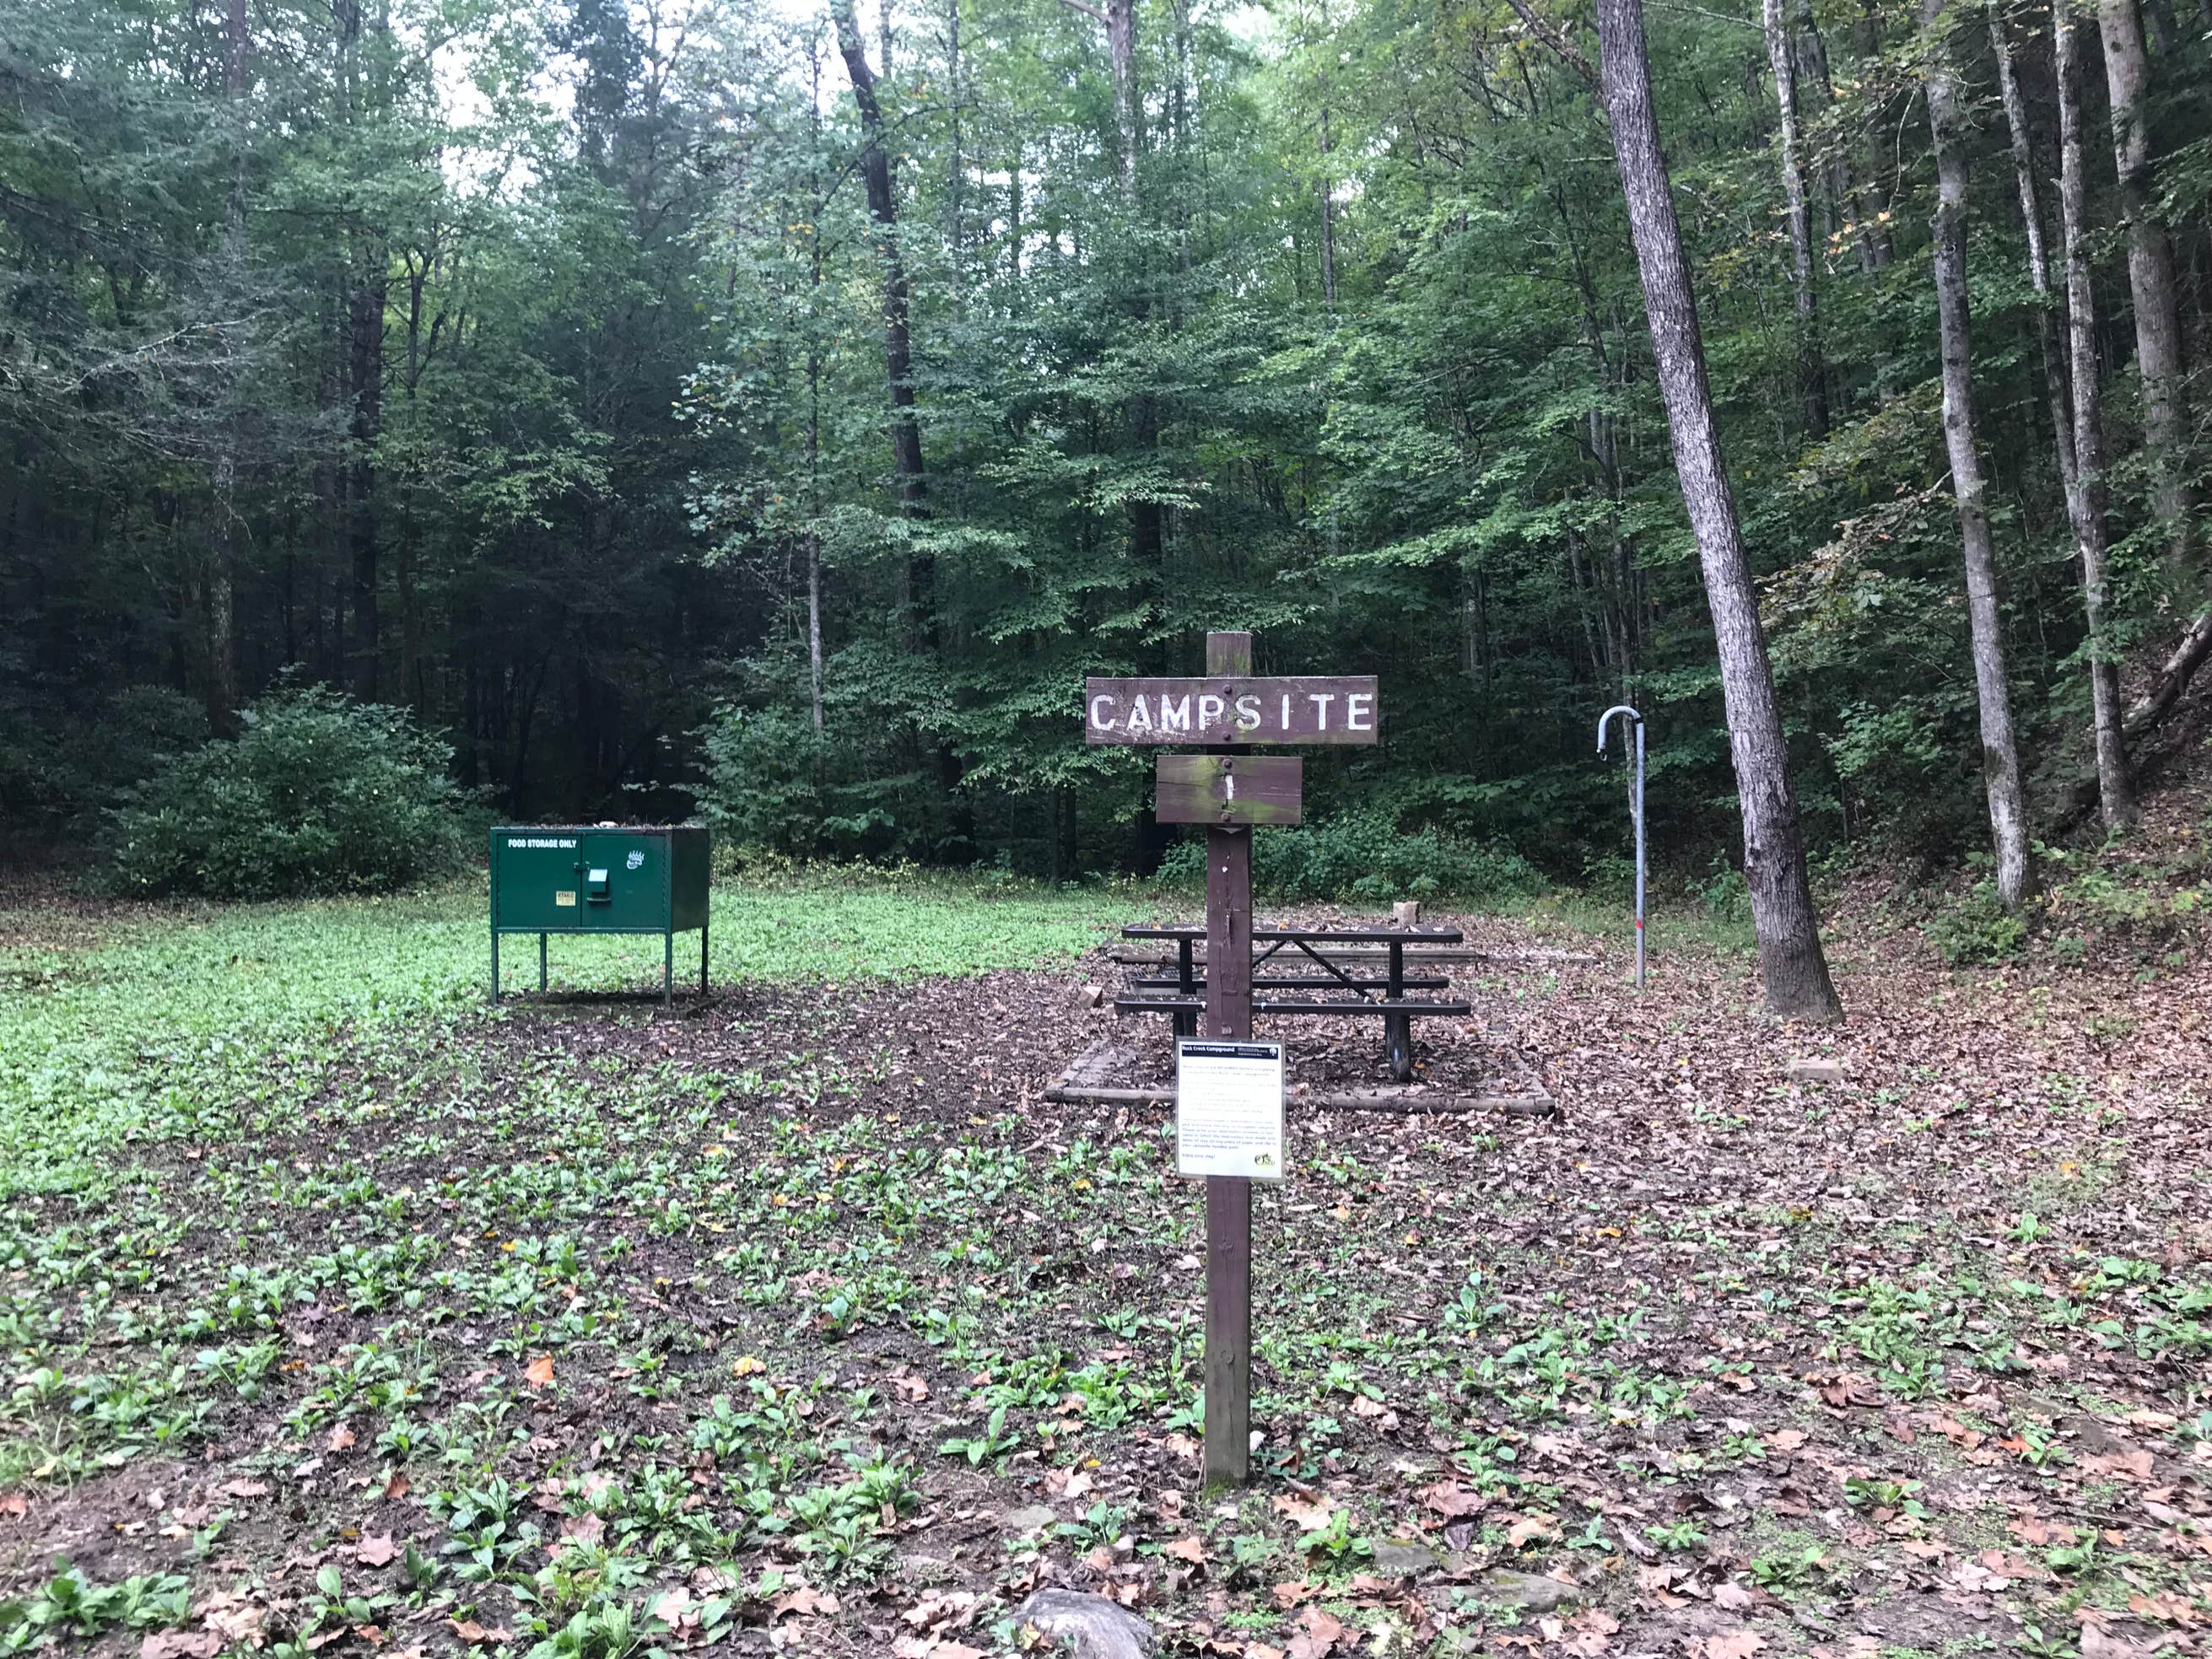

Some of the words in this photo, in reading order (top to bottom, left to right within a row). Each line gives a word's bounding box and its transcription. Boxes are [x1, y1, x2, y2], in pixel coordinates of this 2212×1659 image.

[1090, 692, 1373, 731] CAMPSITE
[508, 838, 526, 848] FOOD
[527, 838, 558, 848] STORAGE
[559, 838, 577, 848] ONLY
